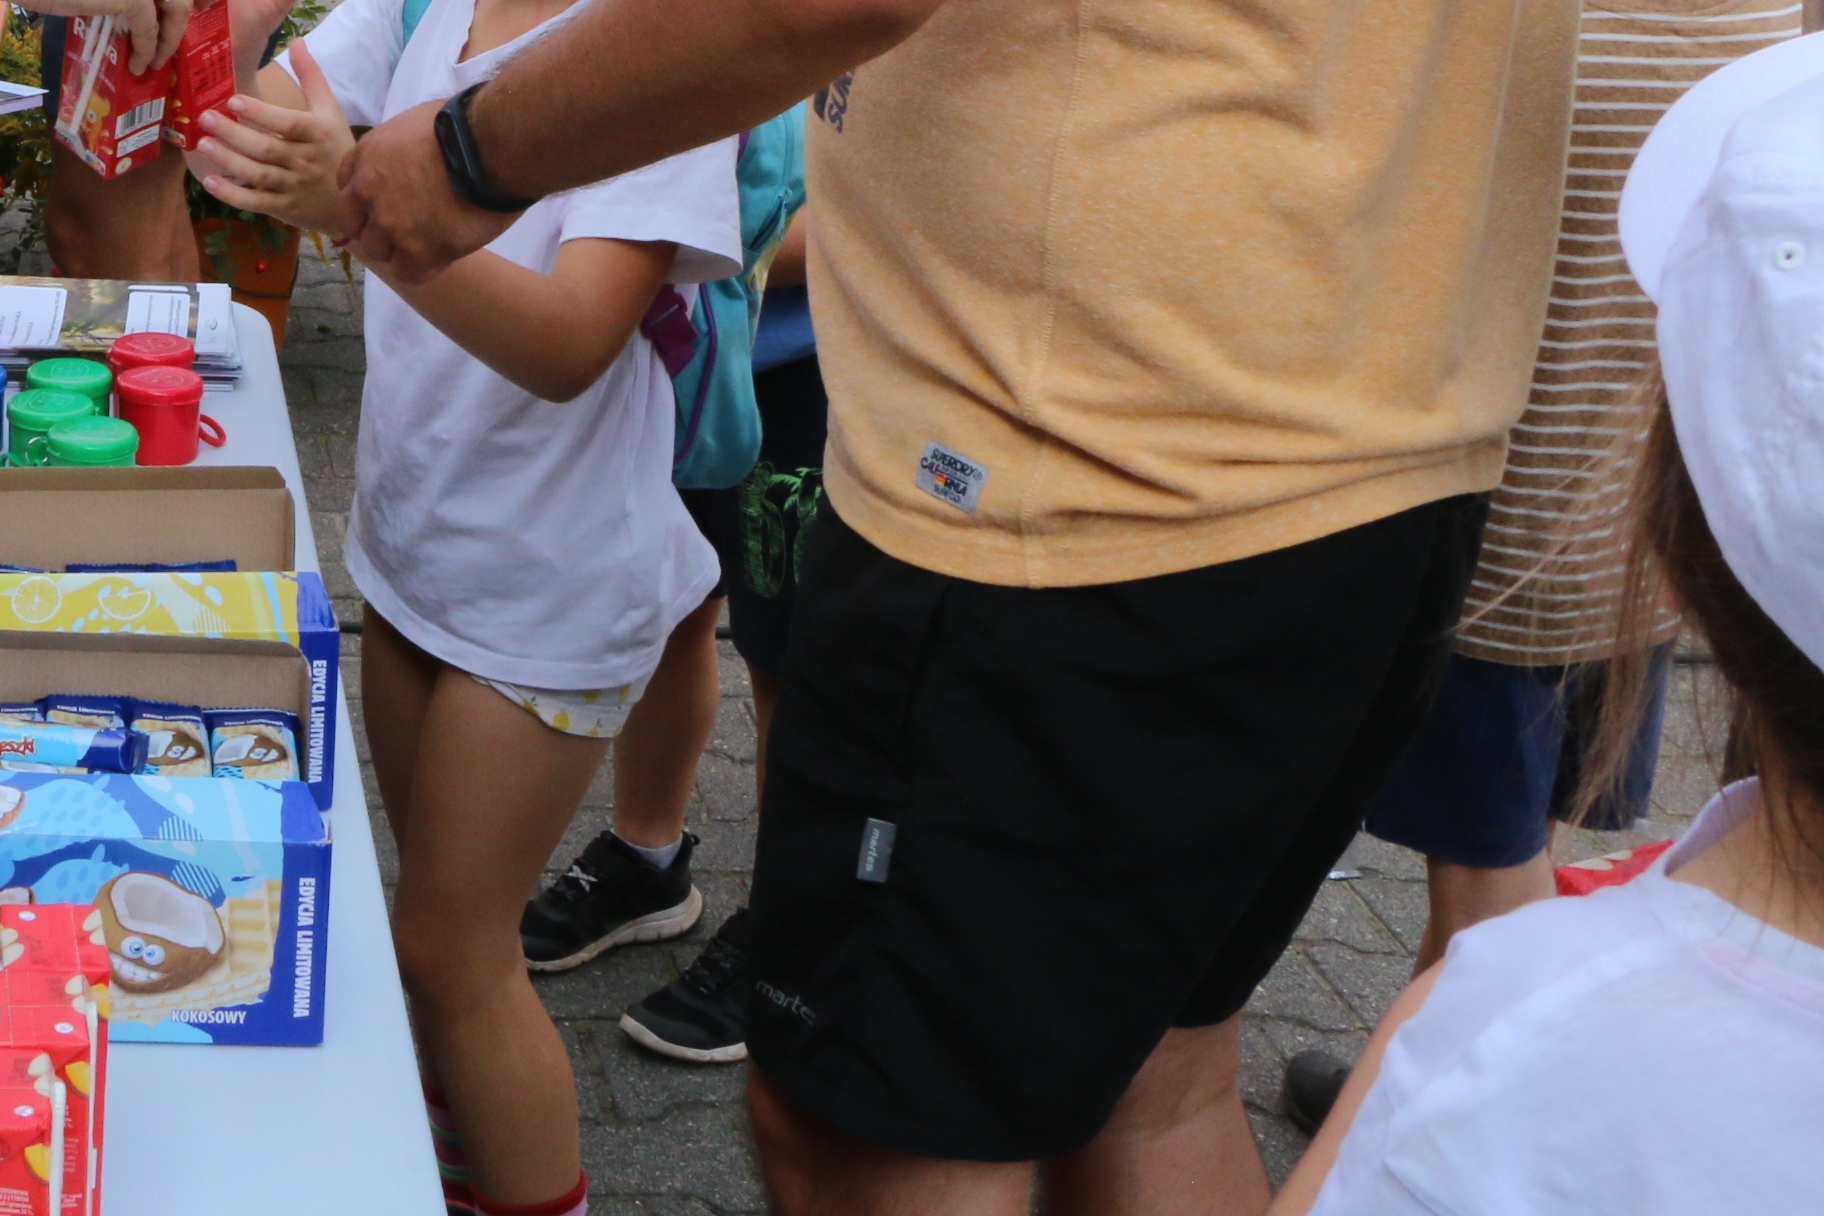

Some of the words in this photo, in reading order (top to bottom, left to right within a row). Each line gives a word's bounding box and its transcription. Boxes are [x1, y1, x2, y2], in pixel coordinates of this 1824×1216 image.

[310, 659, 327, 703] EDYCJA
[307, 706, 325, 784] LIMITOWANA
[297, 877, 315, 926] EDYCJA
[293, 931, 314, 1018] LIMITOWANA
[171, 1009, 247, 1025] KOKOSOWY
[755, 980, 818, 1027] marte
